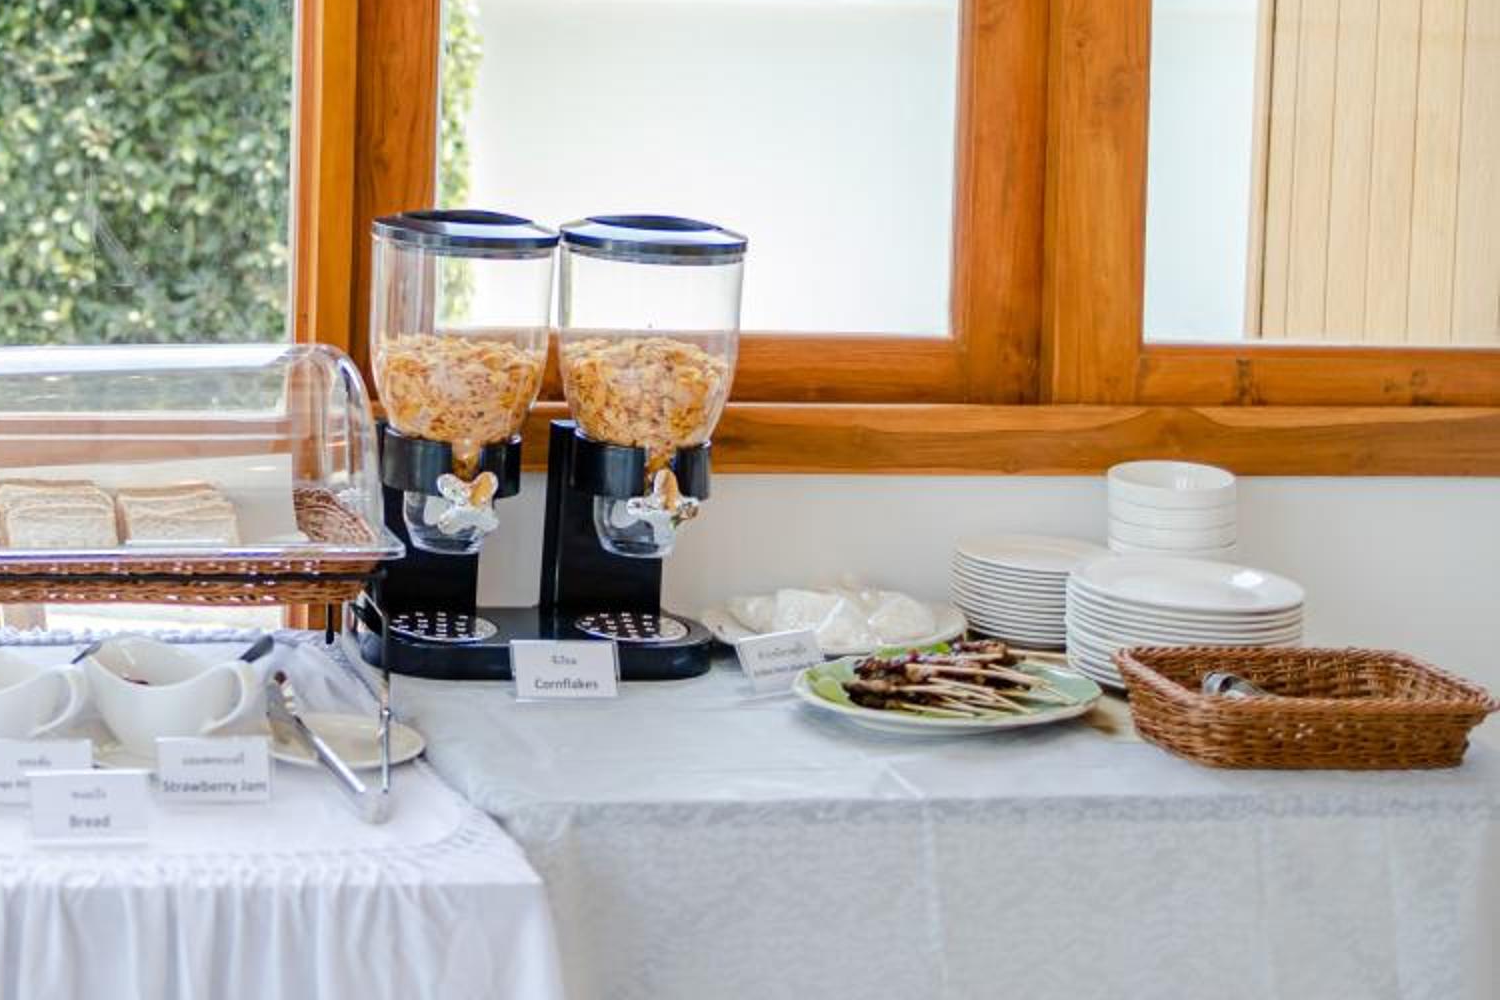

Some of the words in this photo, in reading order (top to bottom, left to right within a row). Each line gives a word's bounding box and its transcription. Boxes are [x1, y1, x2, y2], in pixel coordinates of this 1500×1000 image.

[534, 677, 599, 690] Cornflakes
[163, 780, 237, 795] Strawberry
[240, 779, 267, 792] Jam
[69, 813, 111, 828] Bread
